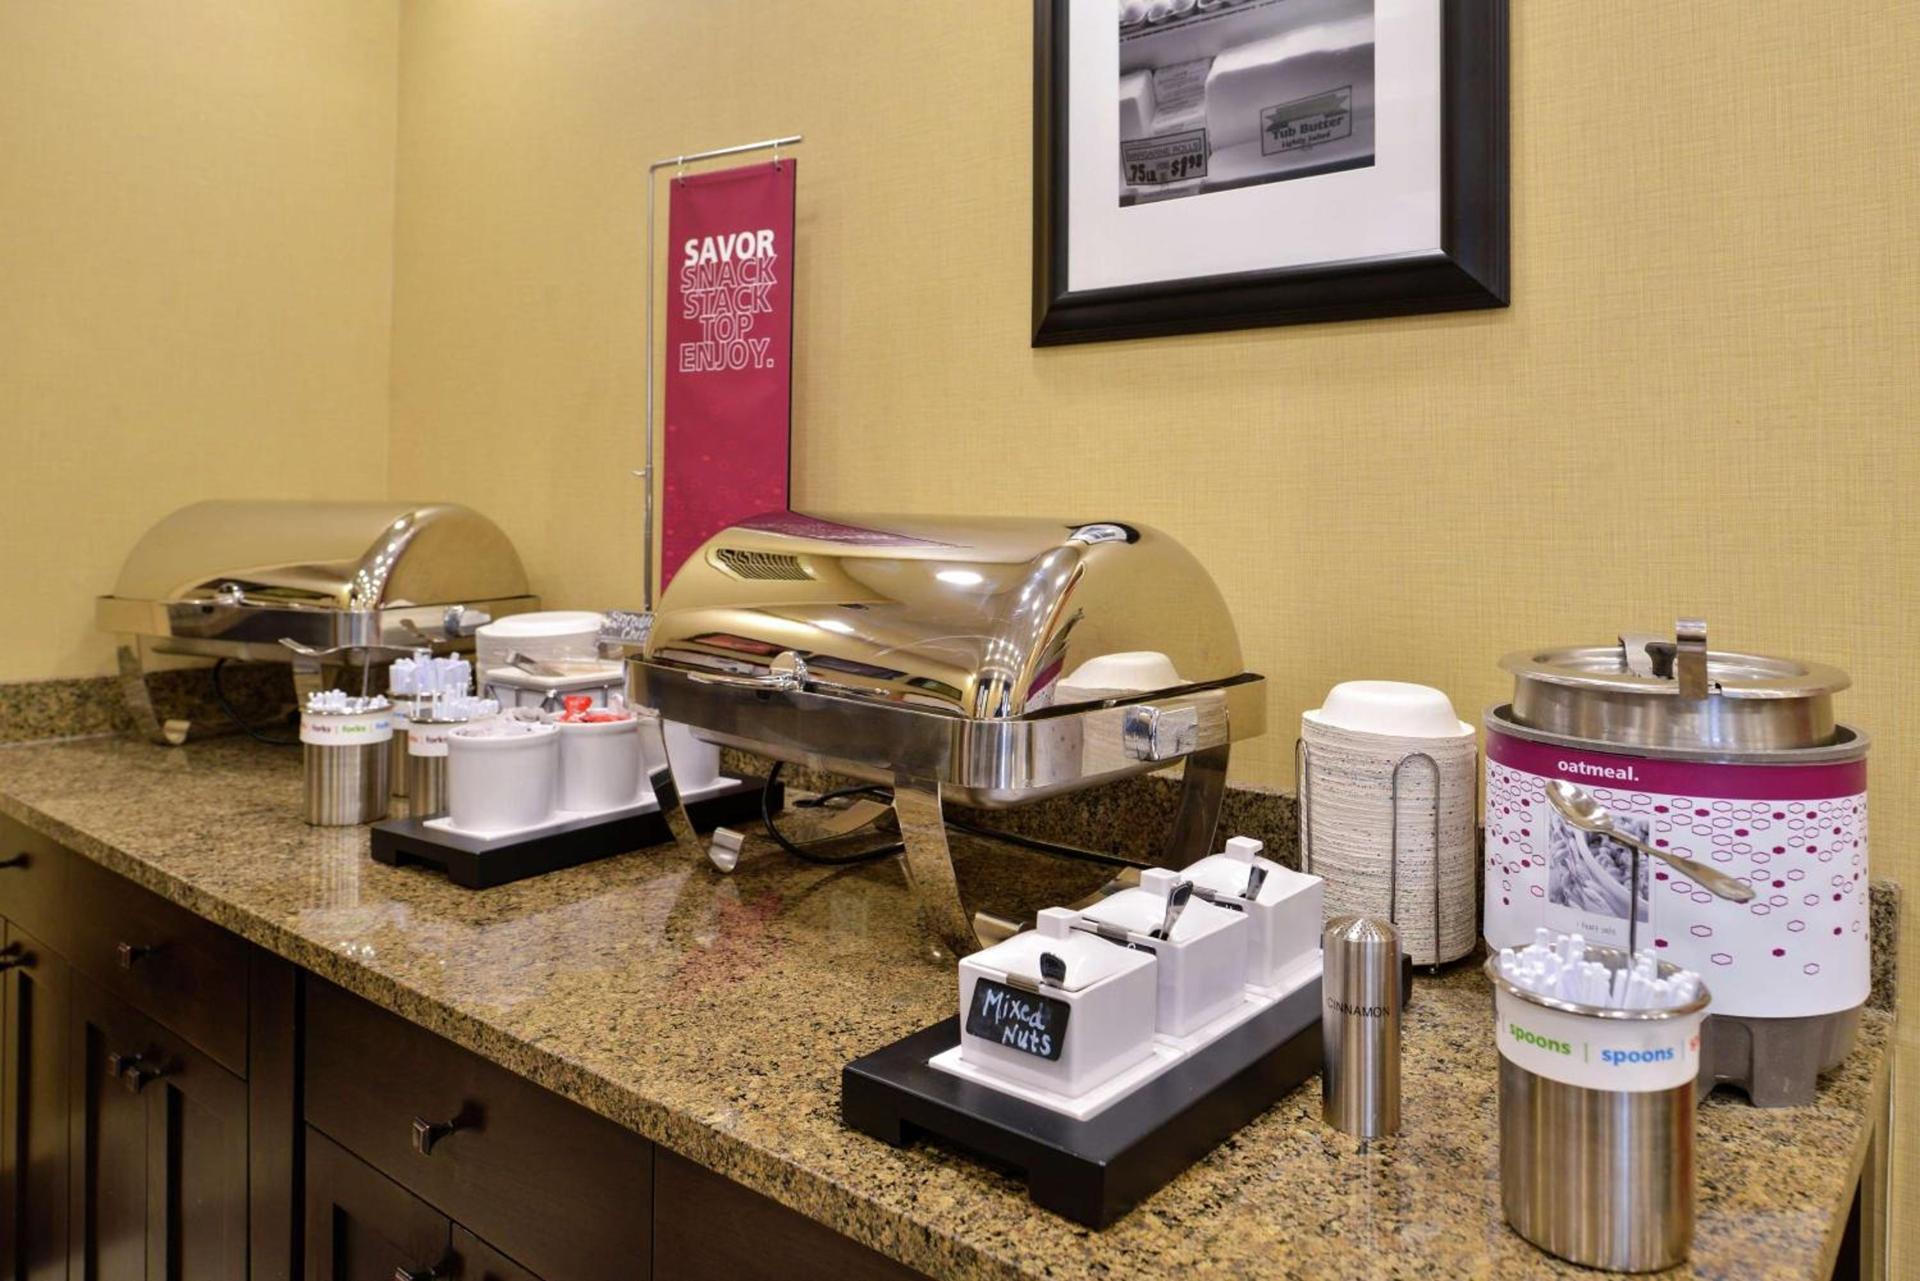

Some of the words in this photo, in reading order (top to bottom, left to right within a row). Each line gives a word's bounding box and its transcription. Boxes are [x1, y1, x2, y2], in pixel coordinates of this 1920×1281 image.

[1300, 116, 1344, 135] Butter
[684, 229, 775, 266] SAVOR
[681, 254, 777, 293] SNACK
[683, 283, 772, 319] STACK
[700, 312, 753, 343] TOP
[678, 337, 774, 373] ENJOY.
[1558, 760, 1639, 782] oatmeal.
[982, 989, 1045, 1031] Mixed
[1327, 997, 1391, 1018] CINNAMON
[1002, 1024, 1052, 1055] Nuts
[1510, 1023, 1573, 1055] spoons
[1601, 1047, 1674, 1066] spoons
